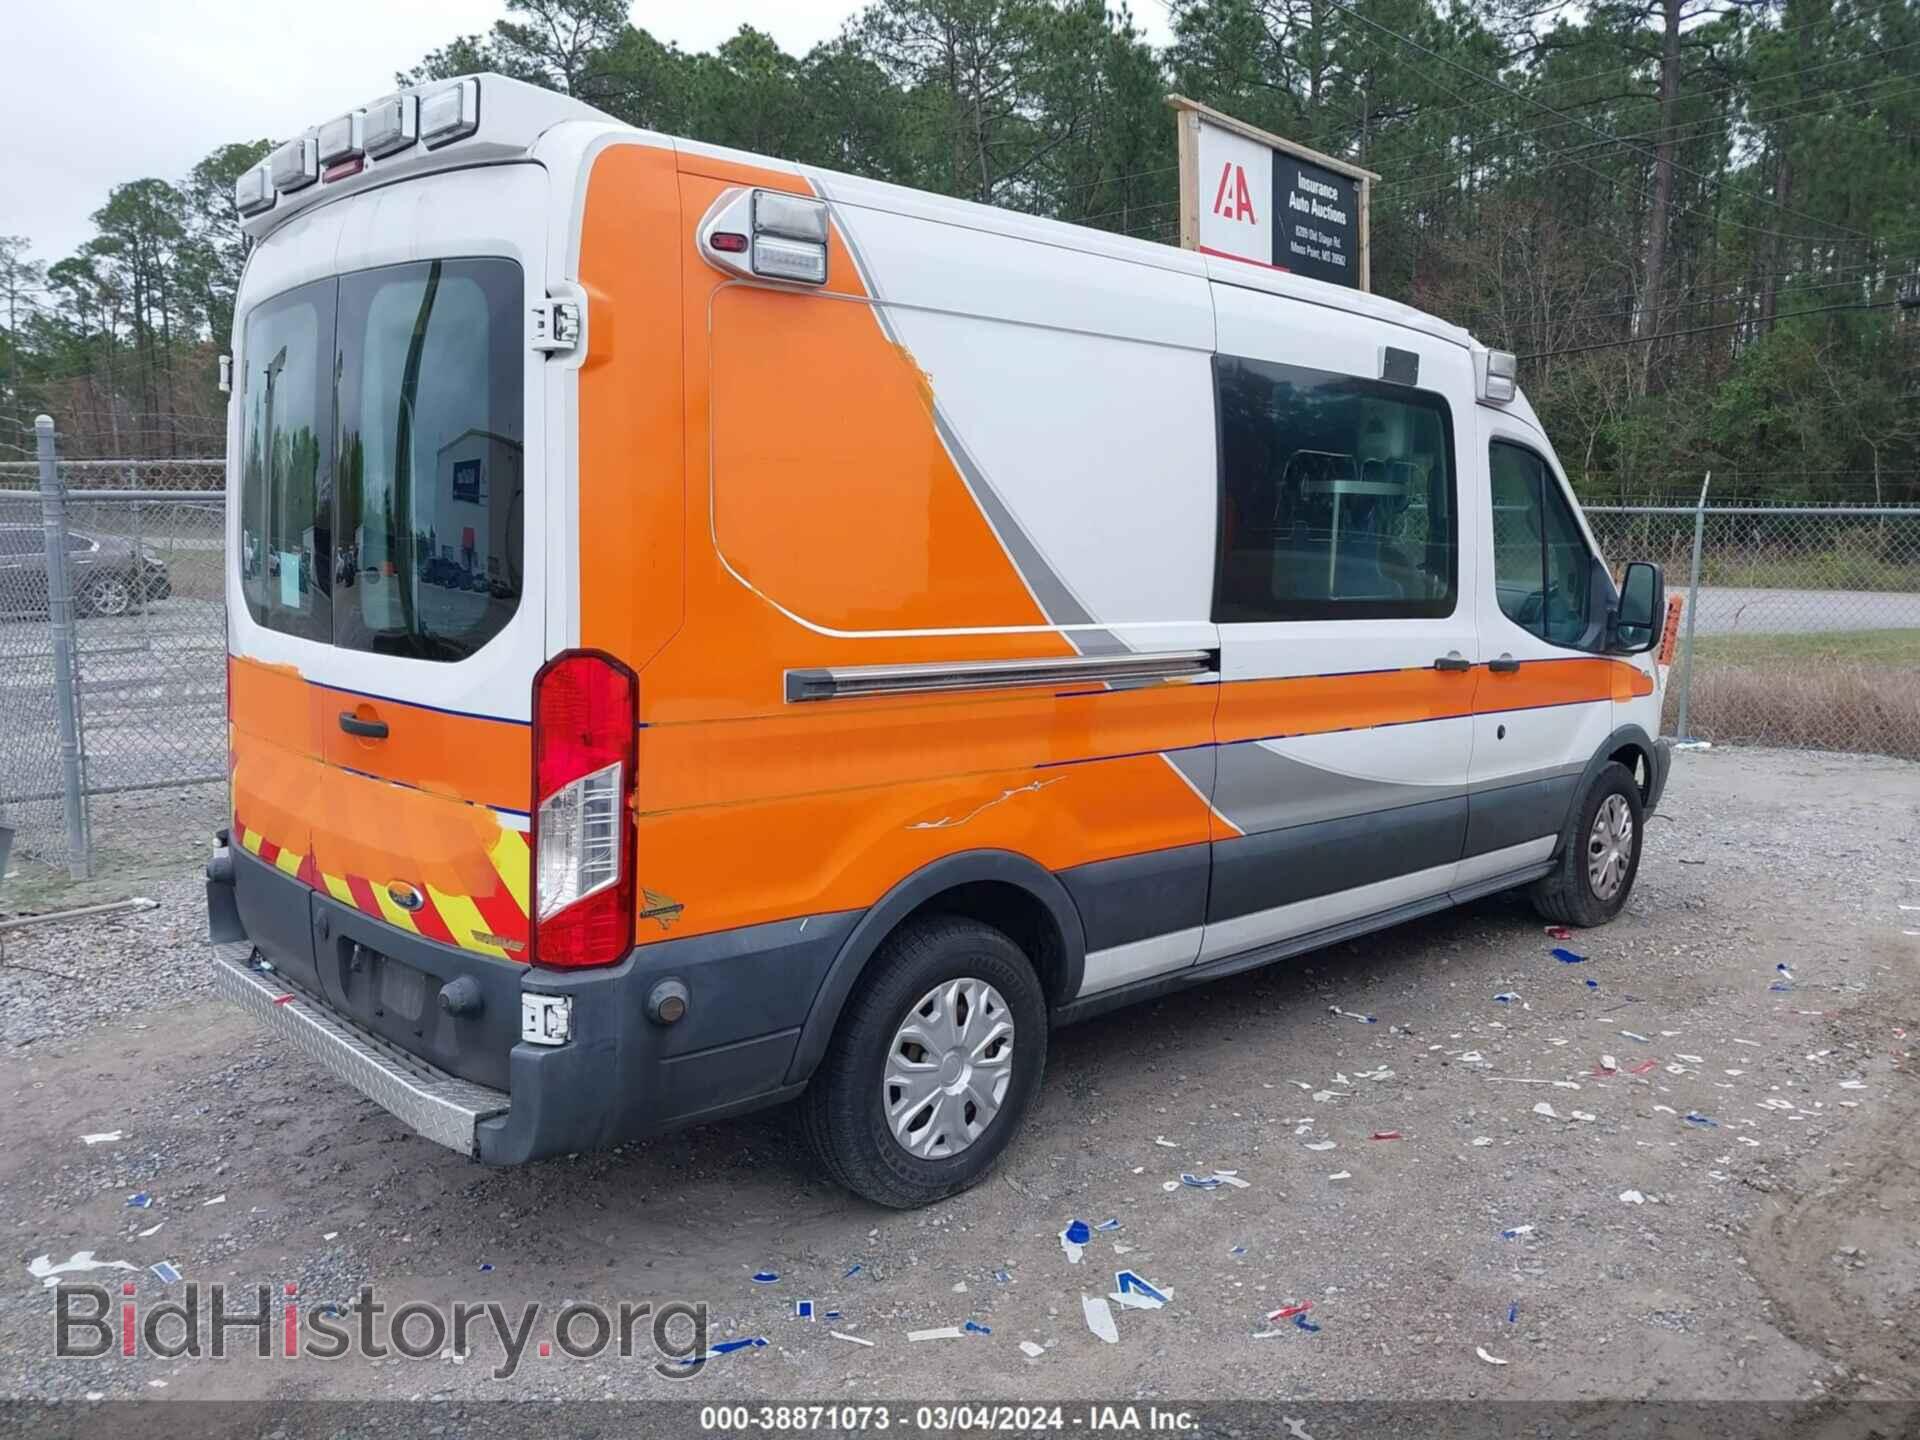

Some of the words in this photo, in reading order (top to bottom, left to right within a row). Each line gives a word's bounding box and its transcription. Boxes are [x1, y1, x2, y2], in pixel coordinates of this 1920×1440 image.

[1298, 171, 1338, 201] Insurance
[1289, 191, 1310, 213] Auto
[1311, 198, 1347, 225] Auctions
